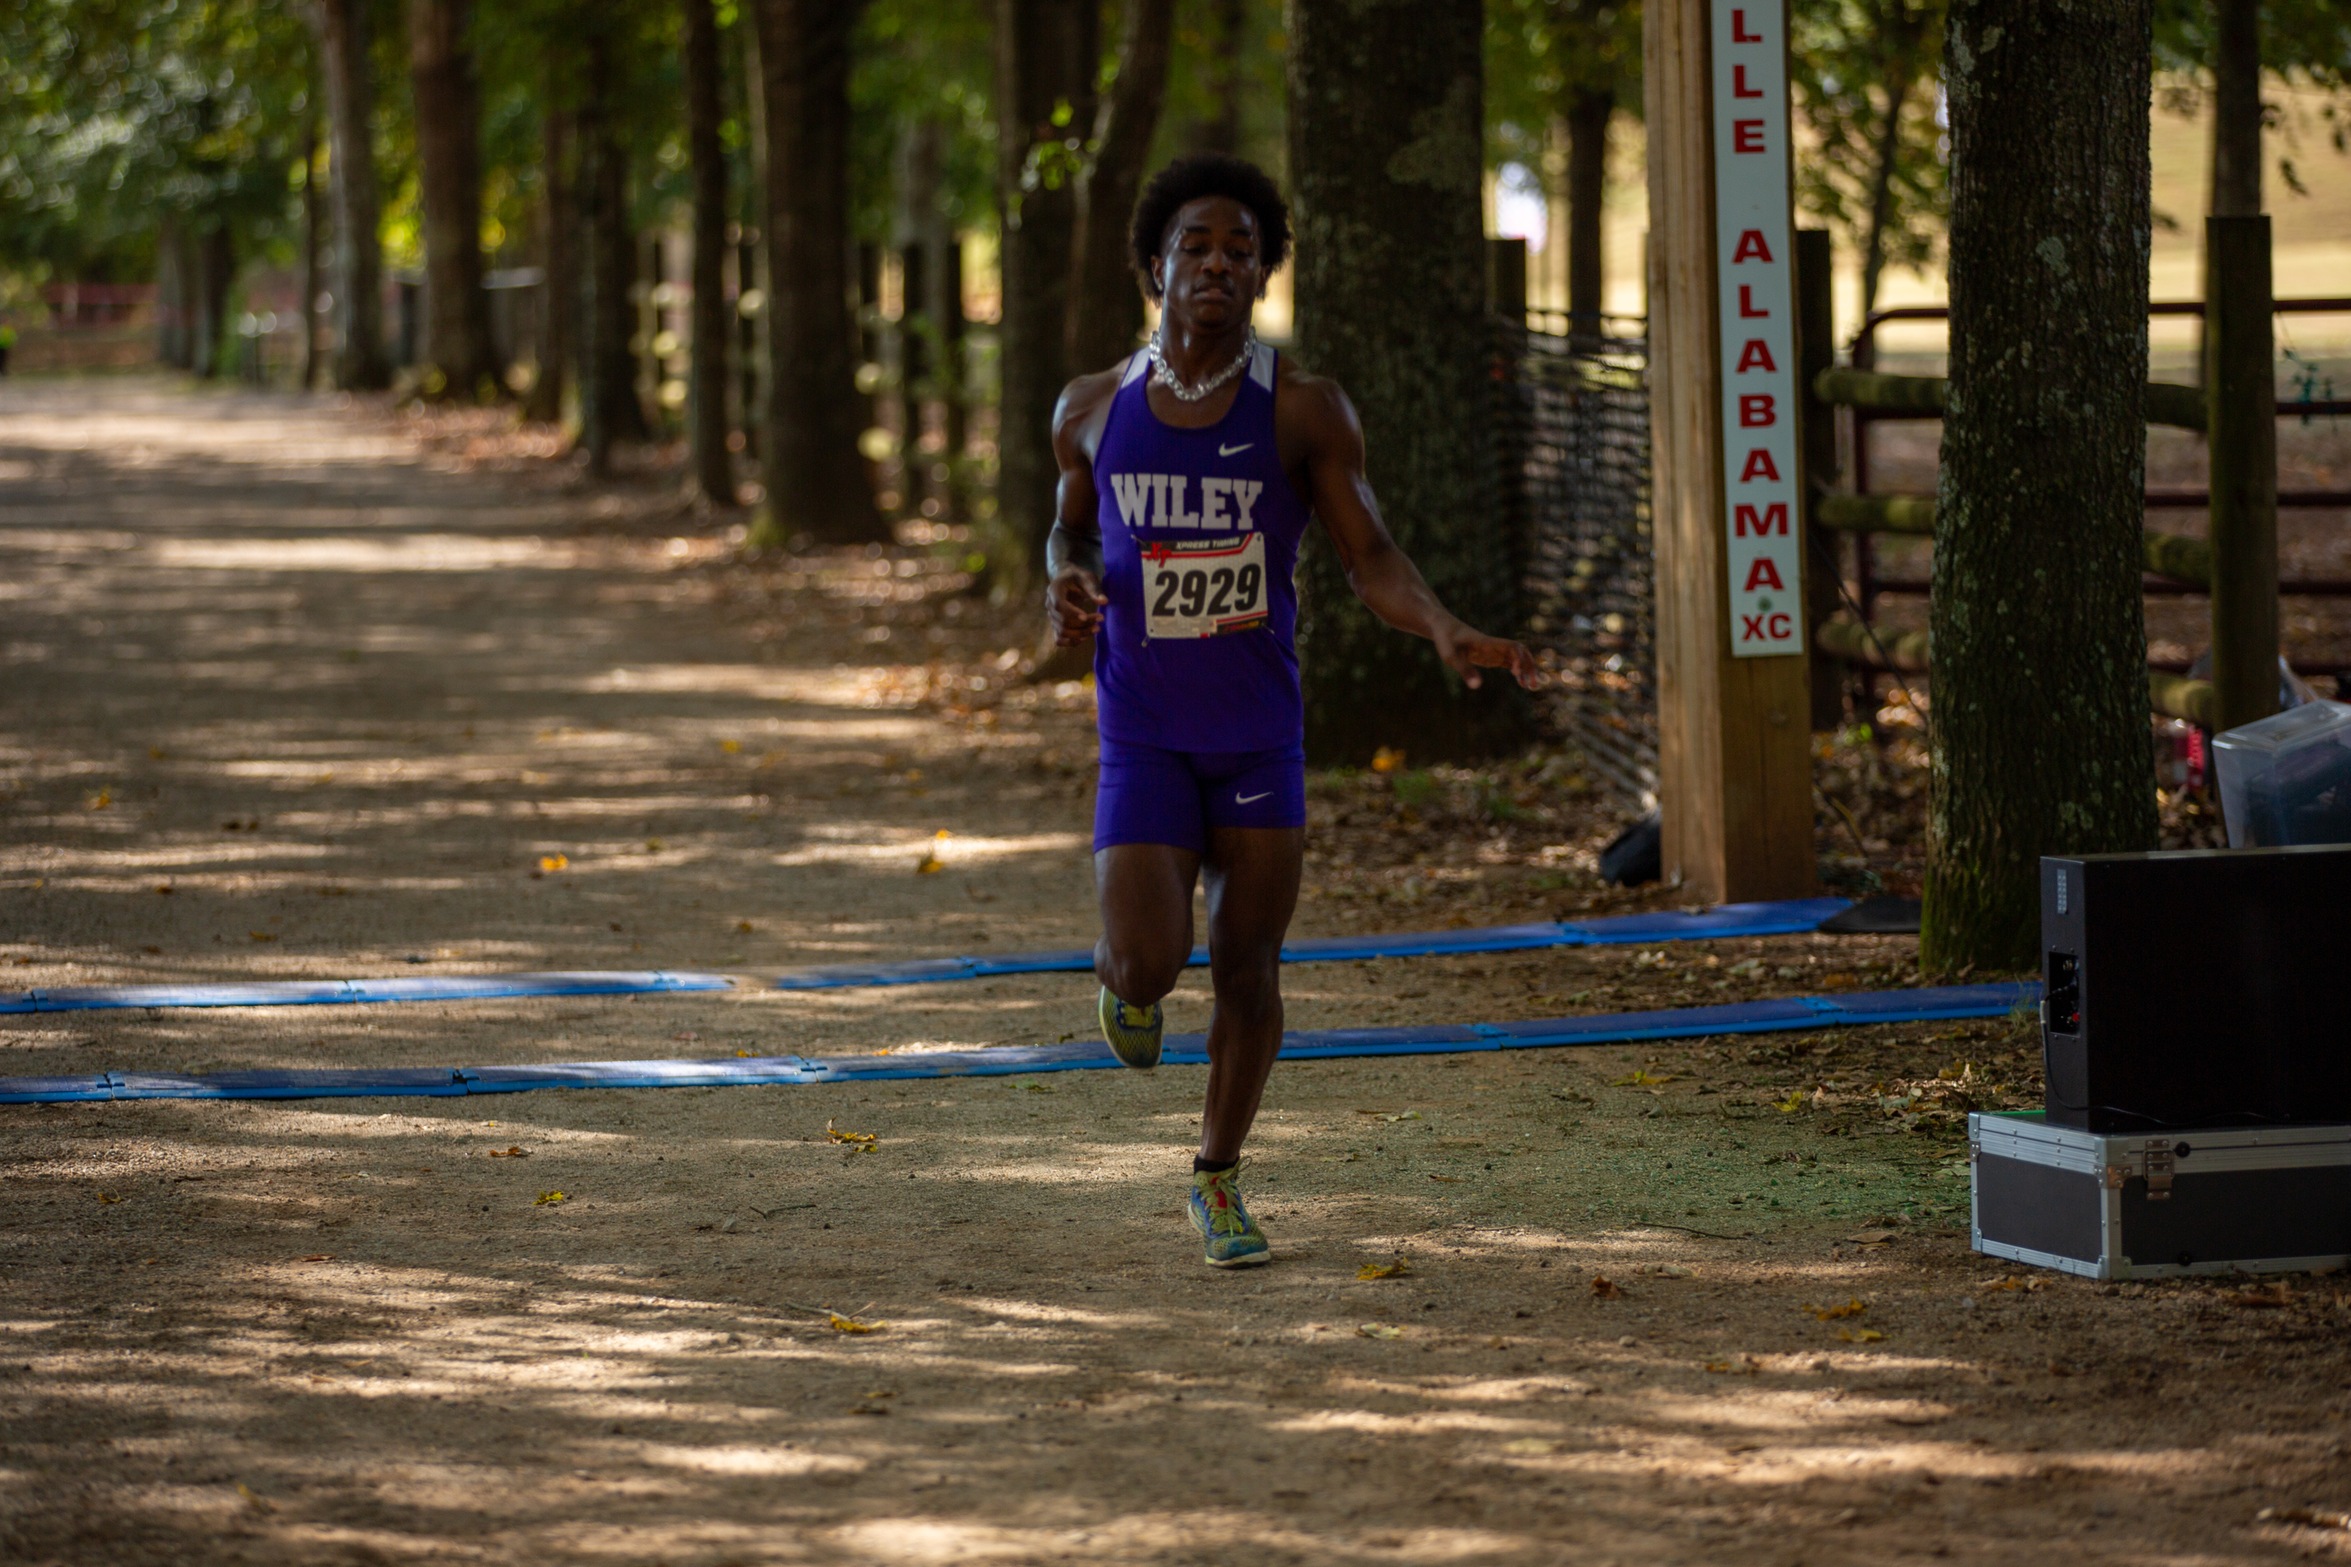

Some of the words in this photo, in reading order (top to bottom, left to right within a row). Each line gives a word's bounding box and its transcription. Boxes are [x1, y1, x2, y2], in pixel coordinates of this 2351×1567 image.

[1731, 8, 1766, 154] LLE
[1732, 228, 1789, 593] ALABAMA
[1110, 473, 1263, 530] WILEY
[1152, 563, 1262, 617] 2929
[1741, 613, 1792, 641] XC
